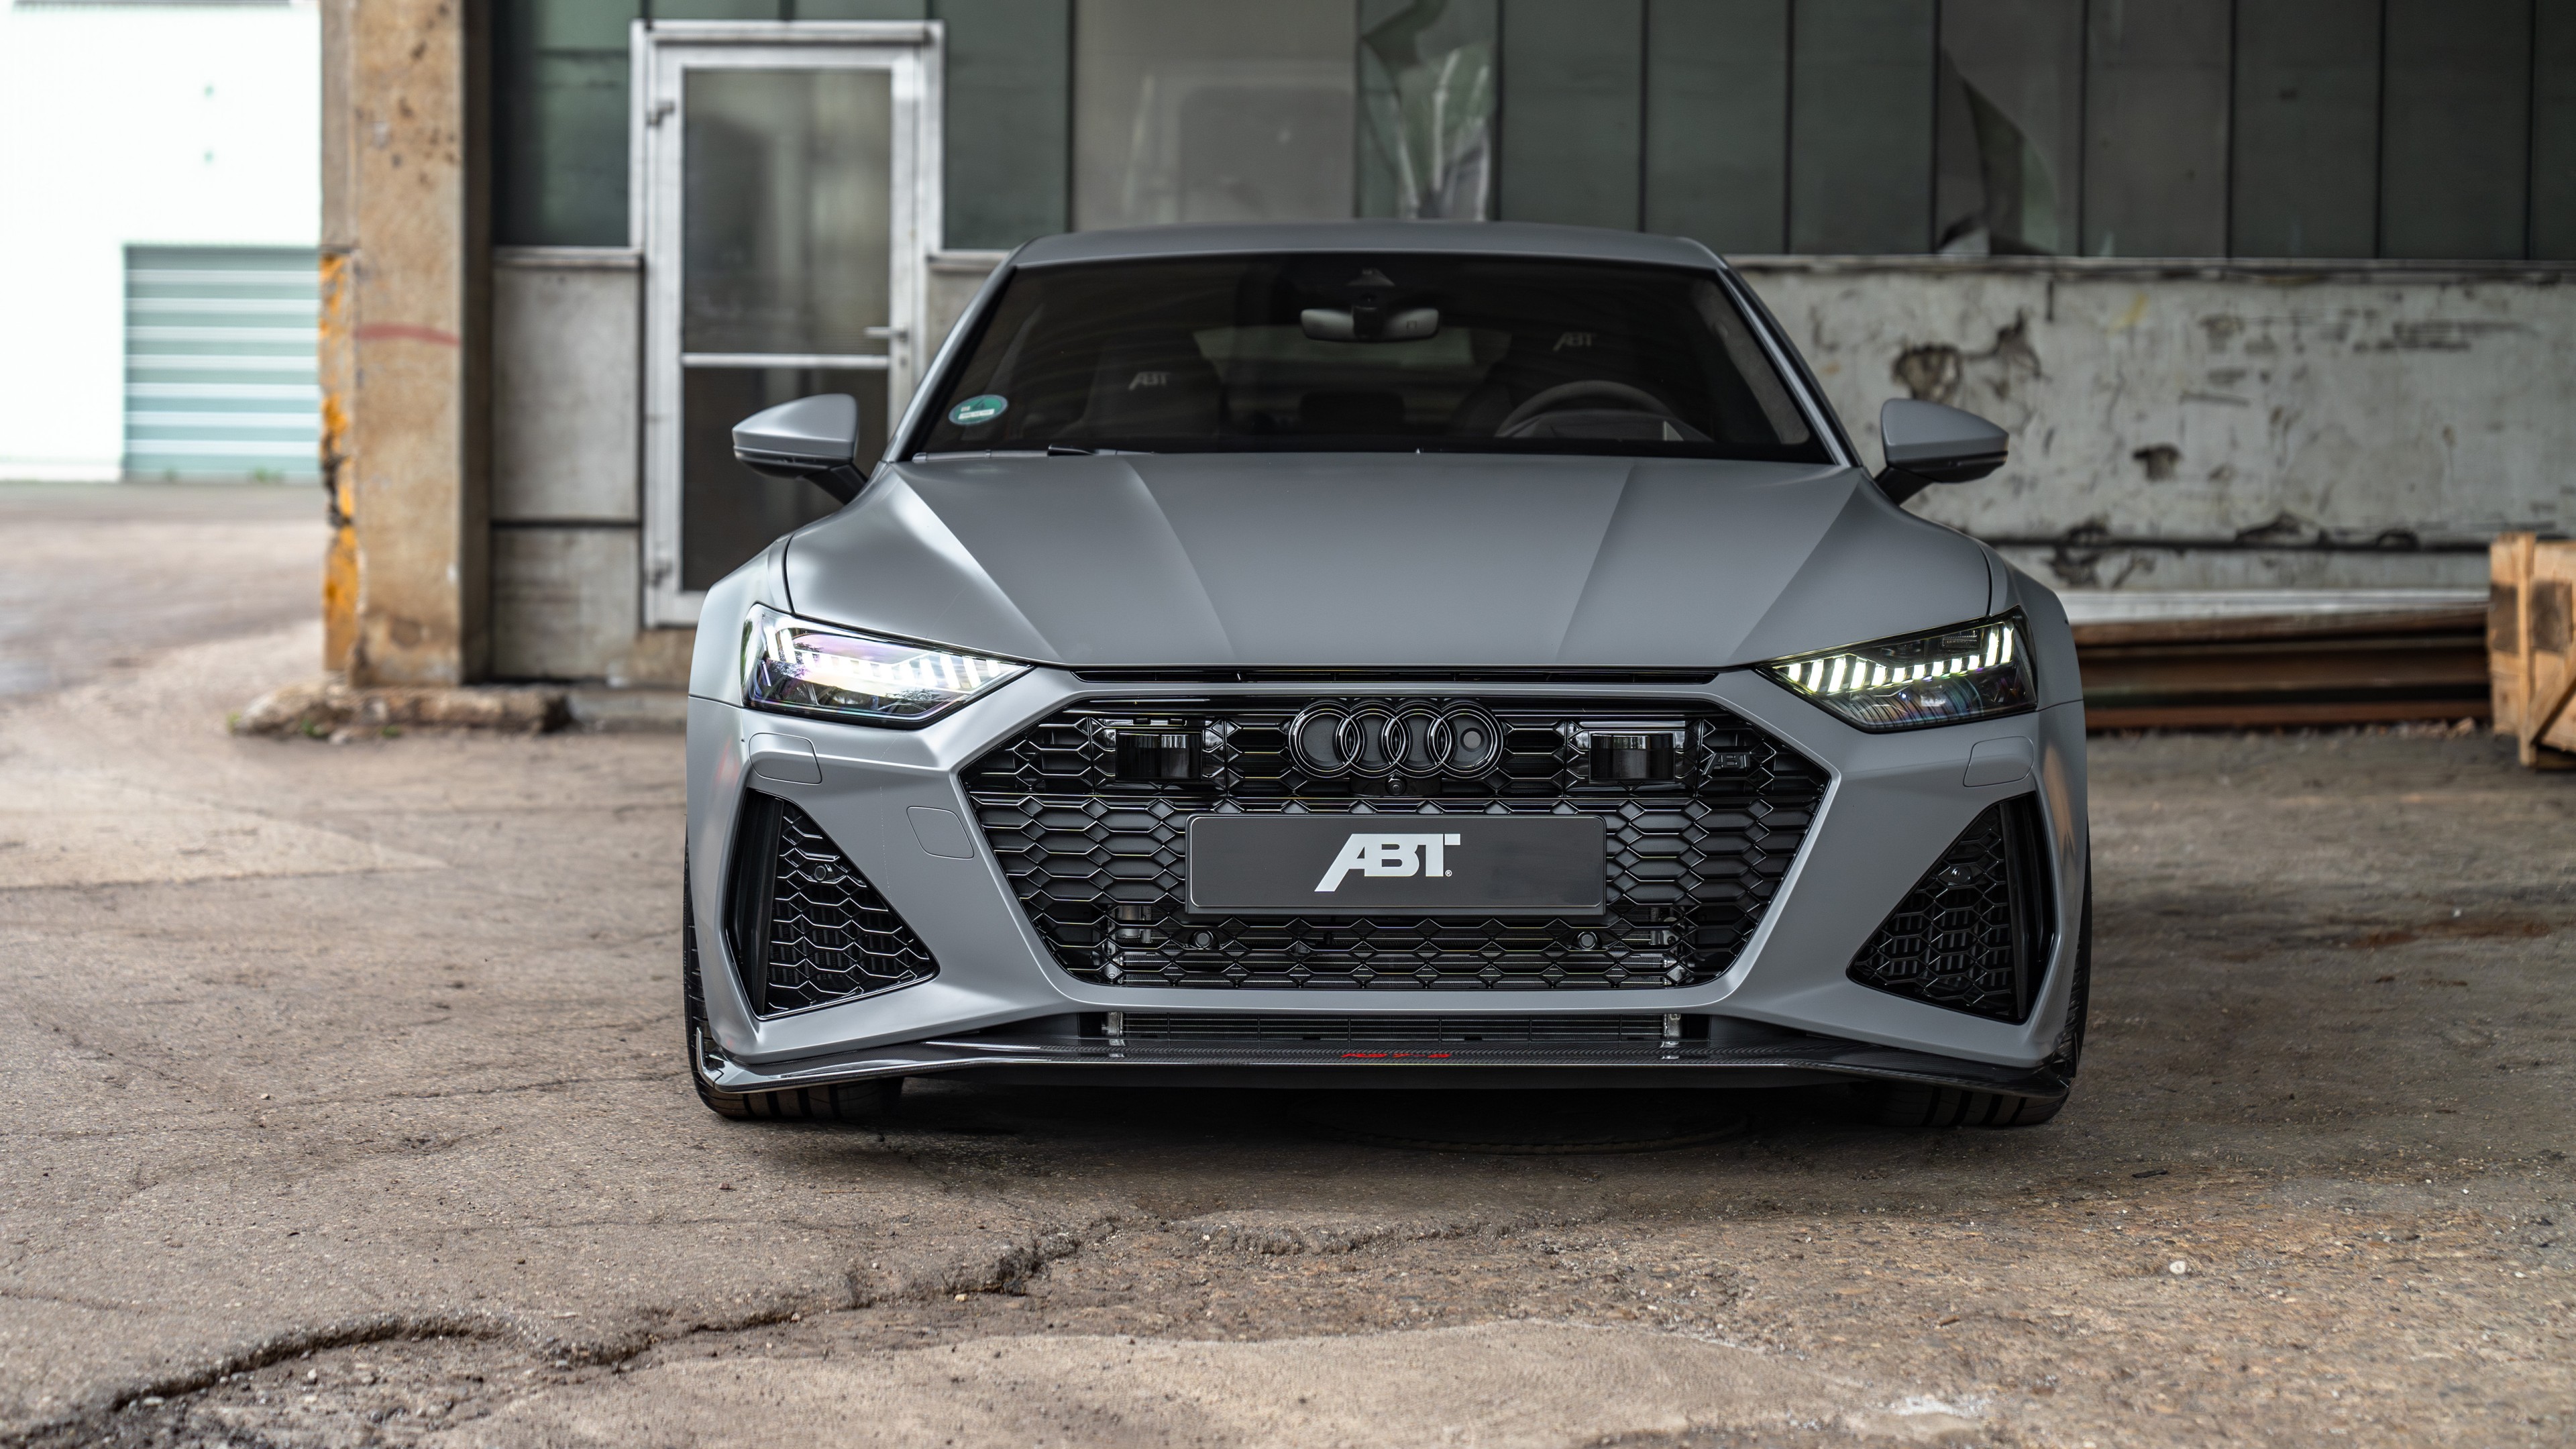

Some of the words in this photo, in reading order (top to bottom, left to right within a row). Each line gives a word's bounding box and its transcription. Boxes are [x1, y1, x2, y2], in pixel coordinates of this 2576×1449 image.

[1552, 332, 1597, 351] ABT
[1128, 371, 1171, 390] ABT
[1702, 753, 1750, 773] ABT
